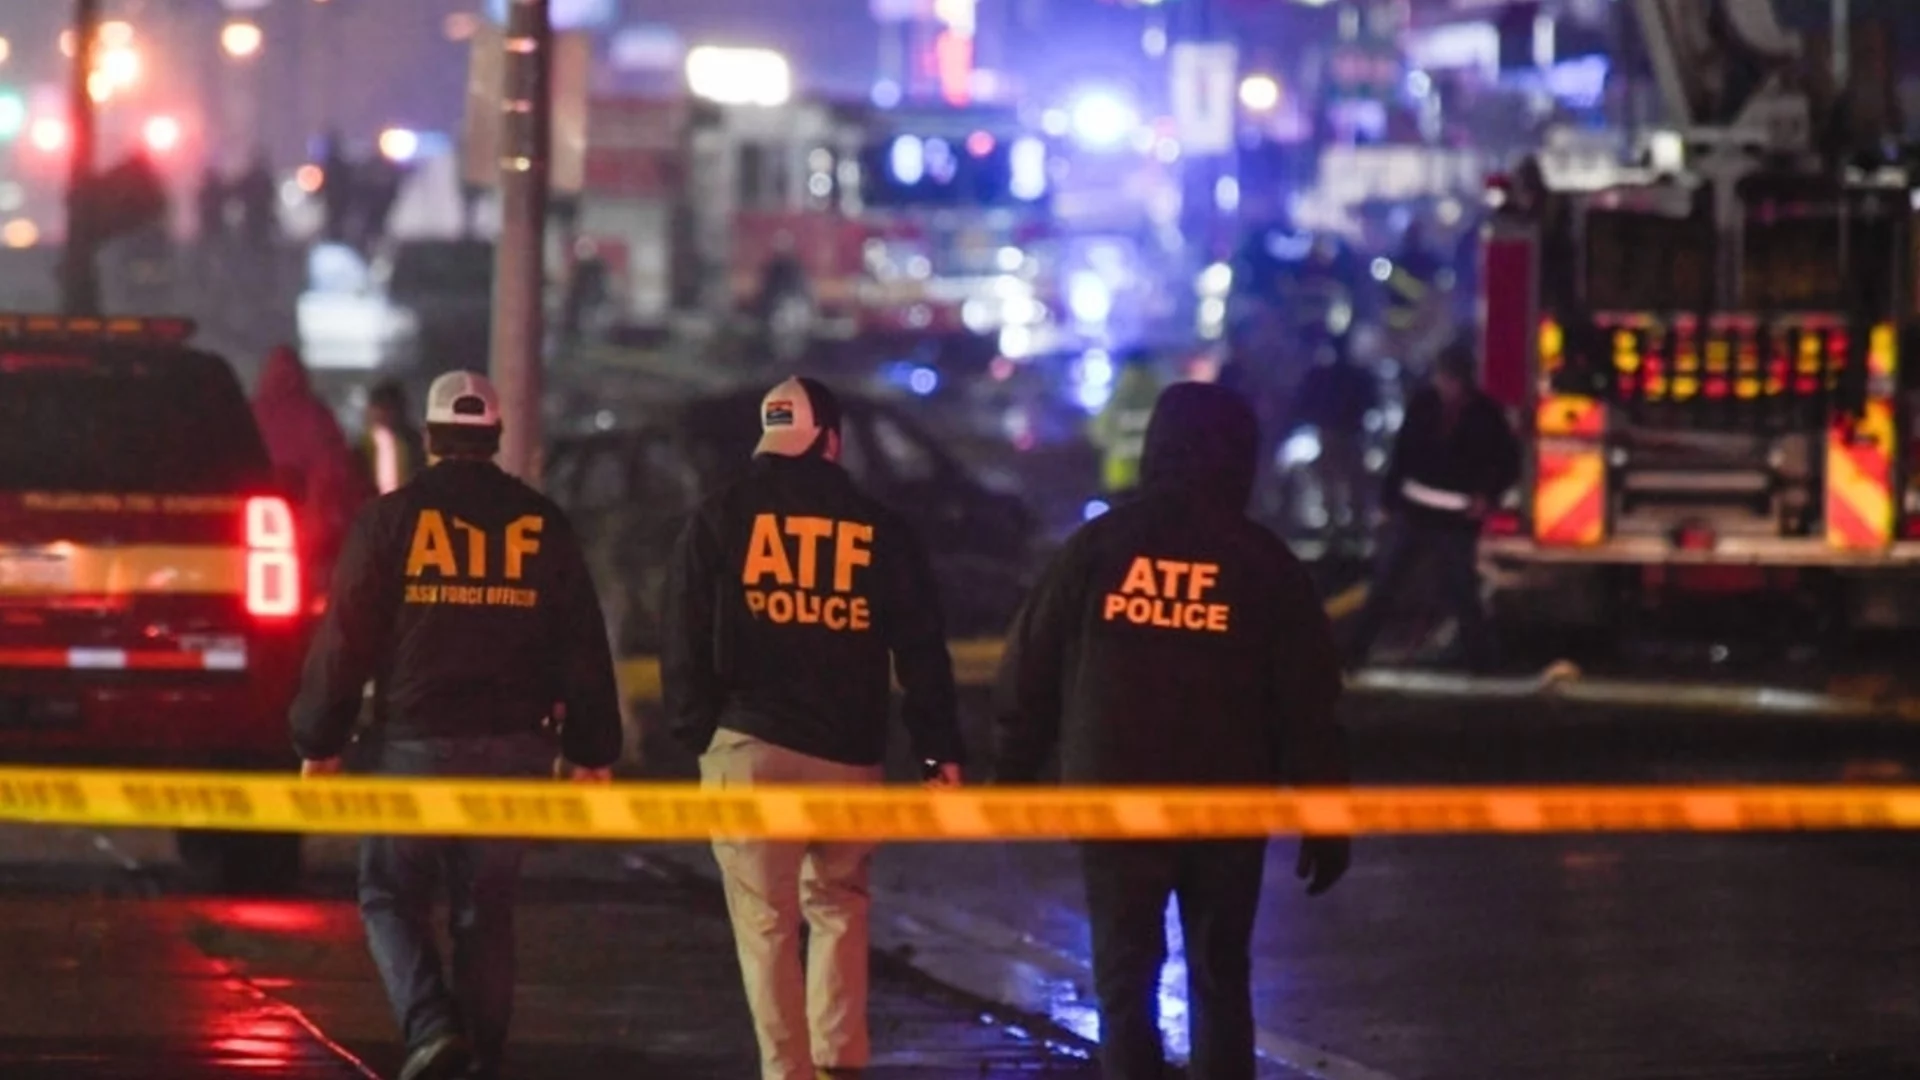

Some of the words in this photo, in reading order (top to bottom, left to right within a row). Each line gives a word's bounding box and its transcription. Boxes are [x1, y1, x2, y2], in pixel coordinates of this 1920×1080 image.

[405, 508, 543, 579] ATF
[742, 513, 873, 592] ATF
[1121, 556, 1219, 601] ATF
[745, 590, 870, 630] POLICE
[1104, 594, 1229, 632] POLICE
